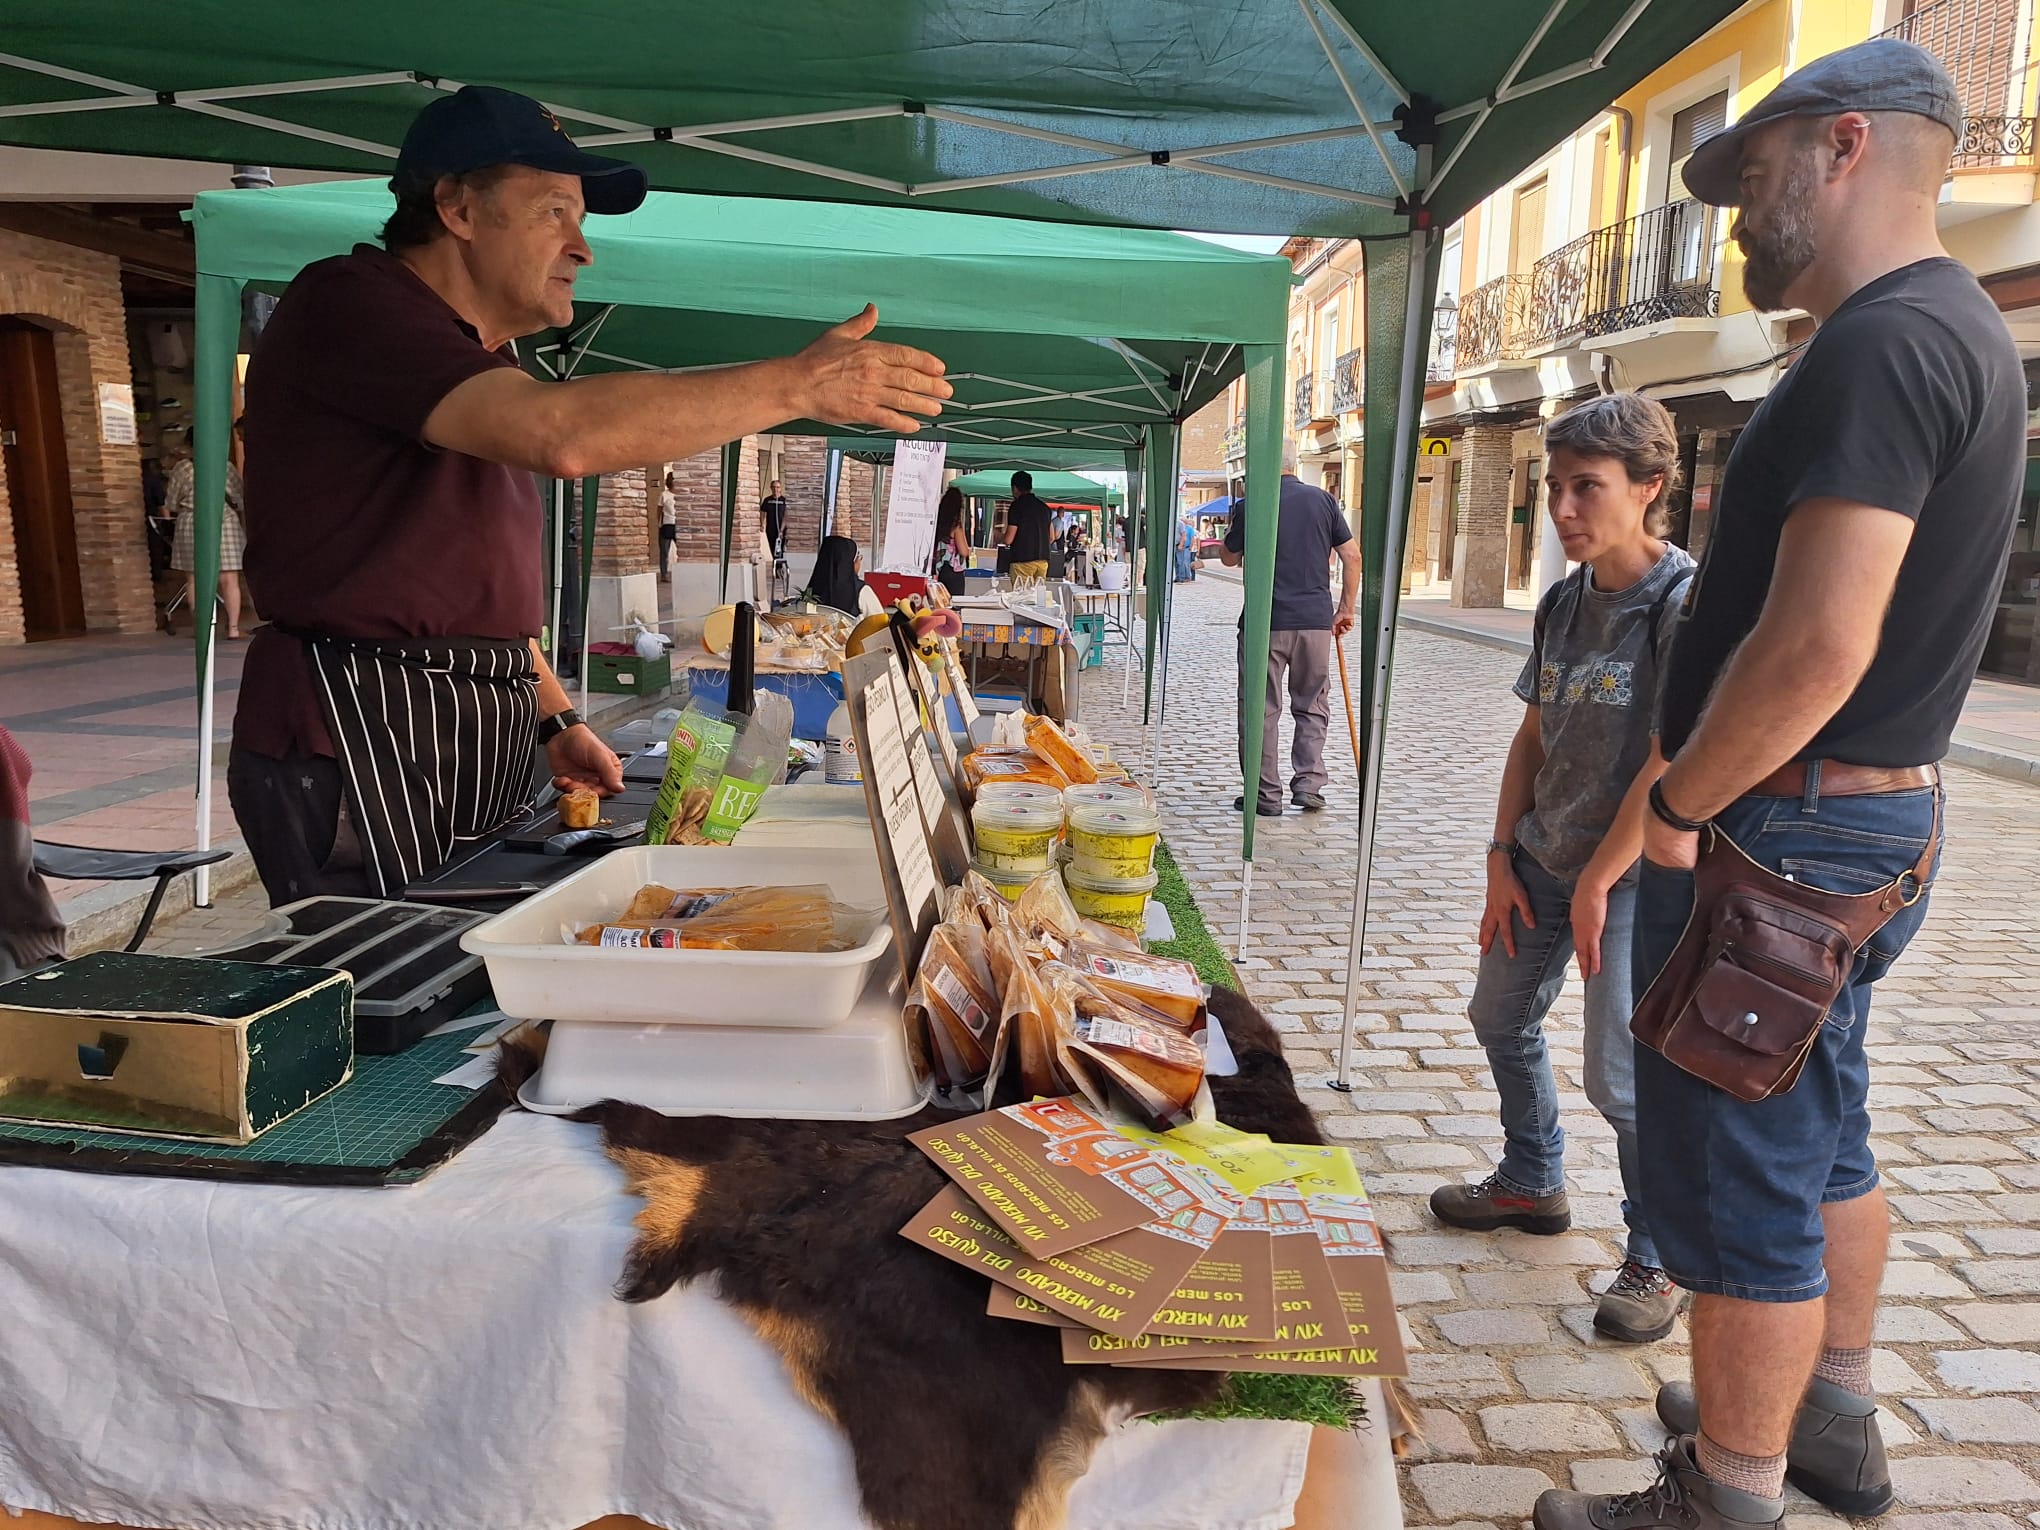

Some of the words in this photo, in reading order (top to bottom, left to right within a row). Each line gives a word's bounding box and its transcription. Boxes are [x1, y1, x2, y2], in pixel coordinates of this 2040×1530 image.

[928, 1138, 964, 1164] QUESO
[956, 1164, 983, 1180] DEL
[992, 1162, 1006, 1173] DE
[1220, 1160, 1245, 1174] 20
[1310, 1176, 1336, 1187] 20
[1003, 1173, 1051, 1214] MERCADOS
[977, 1182, 1032, 1224] MERCADO
[1048, 1213, 1071, 1230] LOS
[1024, 1225, 1050, 1241] XIV
[928, 1226, 981, 1258] QUESO
[979, 1249, 1014, 1272] DEL
[1016, 1267, 1094, 1312] MERCADO
[1106, 1283, 1136, 1299] LOS
[1214, 1291, 1244, 1302] LOS
[1094, 1304, 1127, 1322] XIV
[1281, 1300, 1311, 1312] LOS
[1218, 1314, 1248, 1328] XIV
[1294, 1322, 1323, 1340] XIV
[1350, 1349, 1378, 1364] XIV
